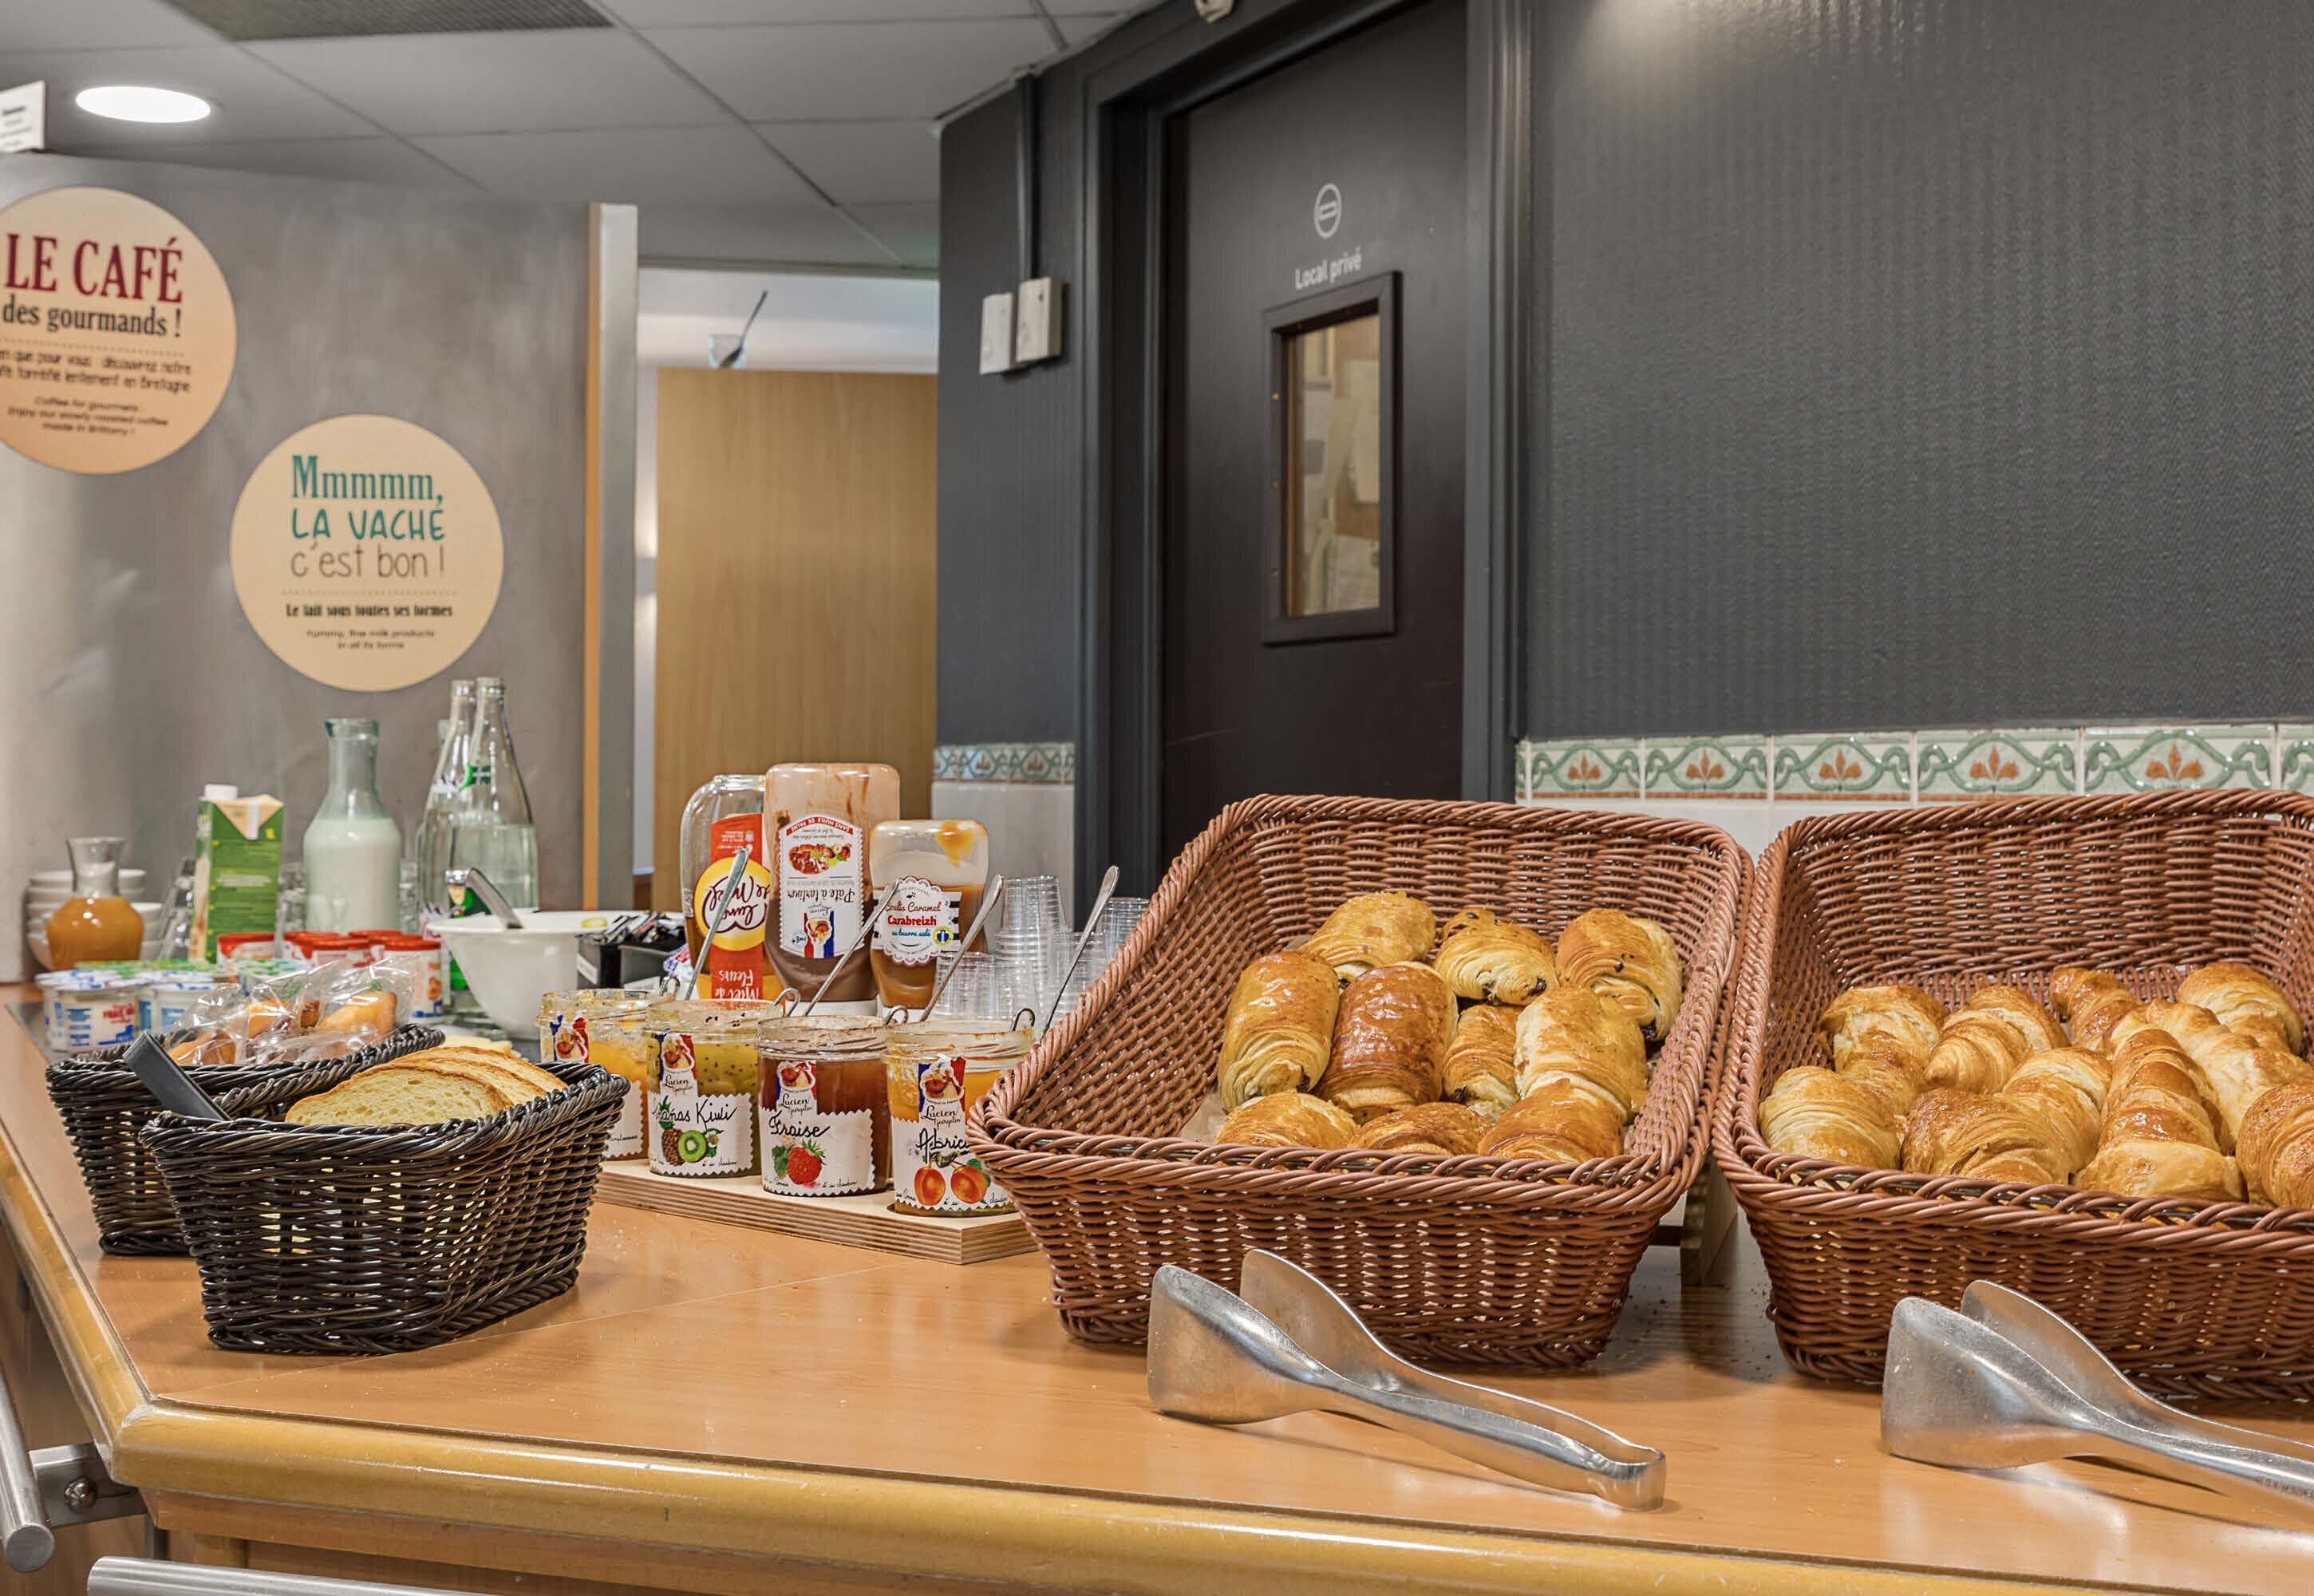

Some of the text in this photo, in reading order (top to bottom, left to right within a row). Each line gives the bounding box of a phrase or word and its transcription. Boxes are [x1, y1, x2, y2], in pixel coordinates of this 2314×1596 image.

[5, 233, 183, 303] LE CAFÉ
[1295, 246, 1361, 290] Local privé
[3, 294, 40, 325] des
[47, 306, 167, 337] gourmands
[292, 455, 444, 506] Mmmmm,
[292, 508, 445, 540] LA VACHE
[290, 541, 363, 579] c'est
[377, 543, 428, 579] bon
[286, 603, 298, 617] Le
[709, 876, 753, 912] Mel
[787, 887, 855, 903] Pâte à tartiner
[885, 900, 942, 912] Coulis Caramel
[887, 915, 937, 926] Carabreizh
[719, 970, 754, 987] Fleurs
[728, 986, 759, 1001] Miel
[664, 1074, 689, 1088] Lucien
[652, 1097, 738, 1128] anas Kiwi
[779, 1093, 810, 1108] Lucien
[921, 1104, 958, 1120] Lucien
[768, 1110, 831, 1137] Fraise
[915, 1128, 969, 1163] Abric
